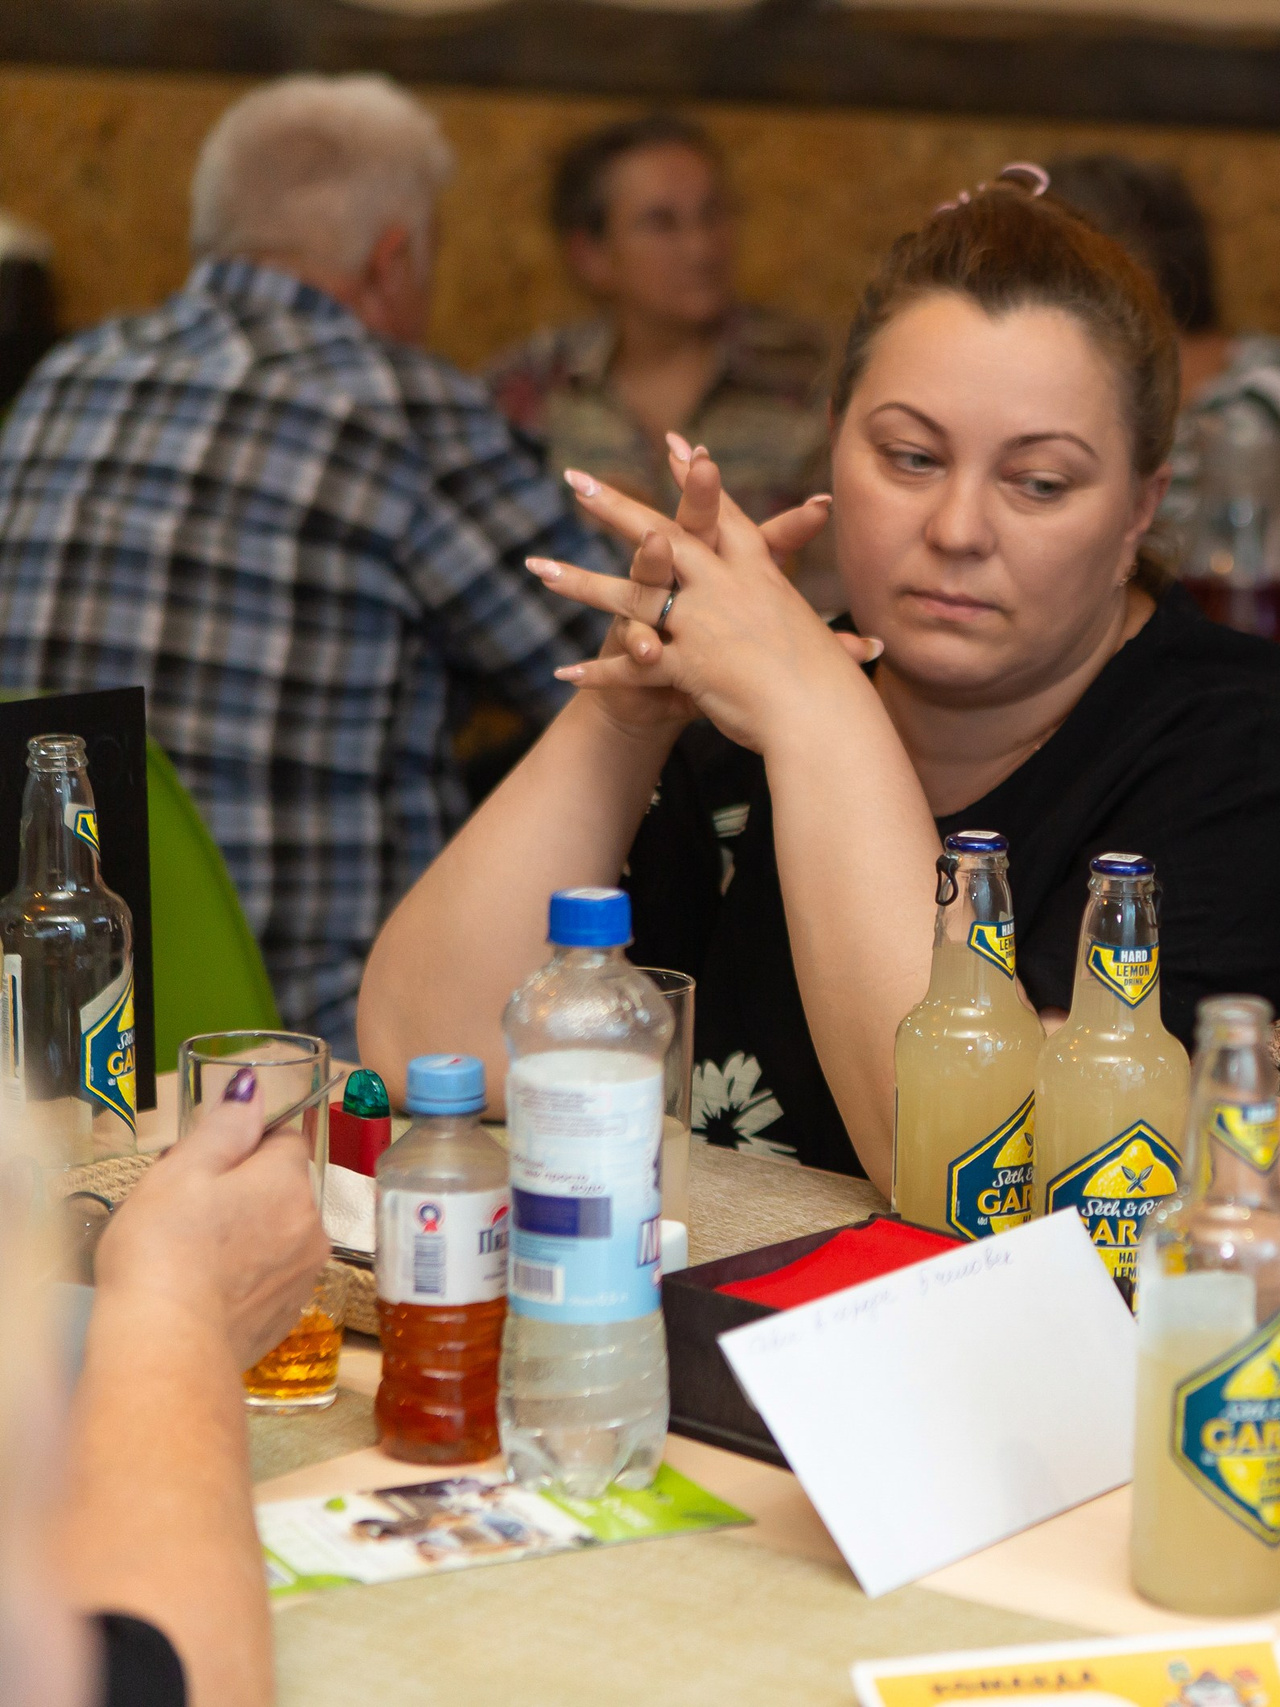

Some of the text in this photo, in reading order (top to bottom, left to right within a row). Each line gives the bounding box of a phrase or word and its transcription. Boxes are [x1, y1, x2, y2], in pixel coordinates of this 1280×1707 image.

[1120, 949, 1148, 963] HARD
[1116, 964, 1150, 978] LEMON
[1123, 978, 1143, 987] DRINK
[992, 1165, 1025, 1188] Seth
[1081, 1198, 1121, 1217] Seth
[1123, 1199, 1138, 1217] &
